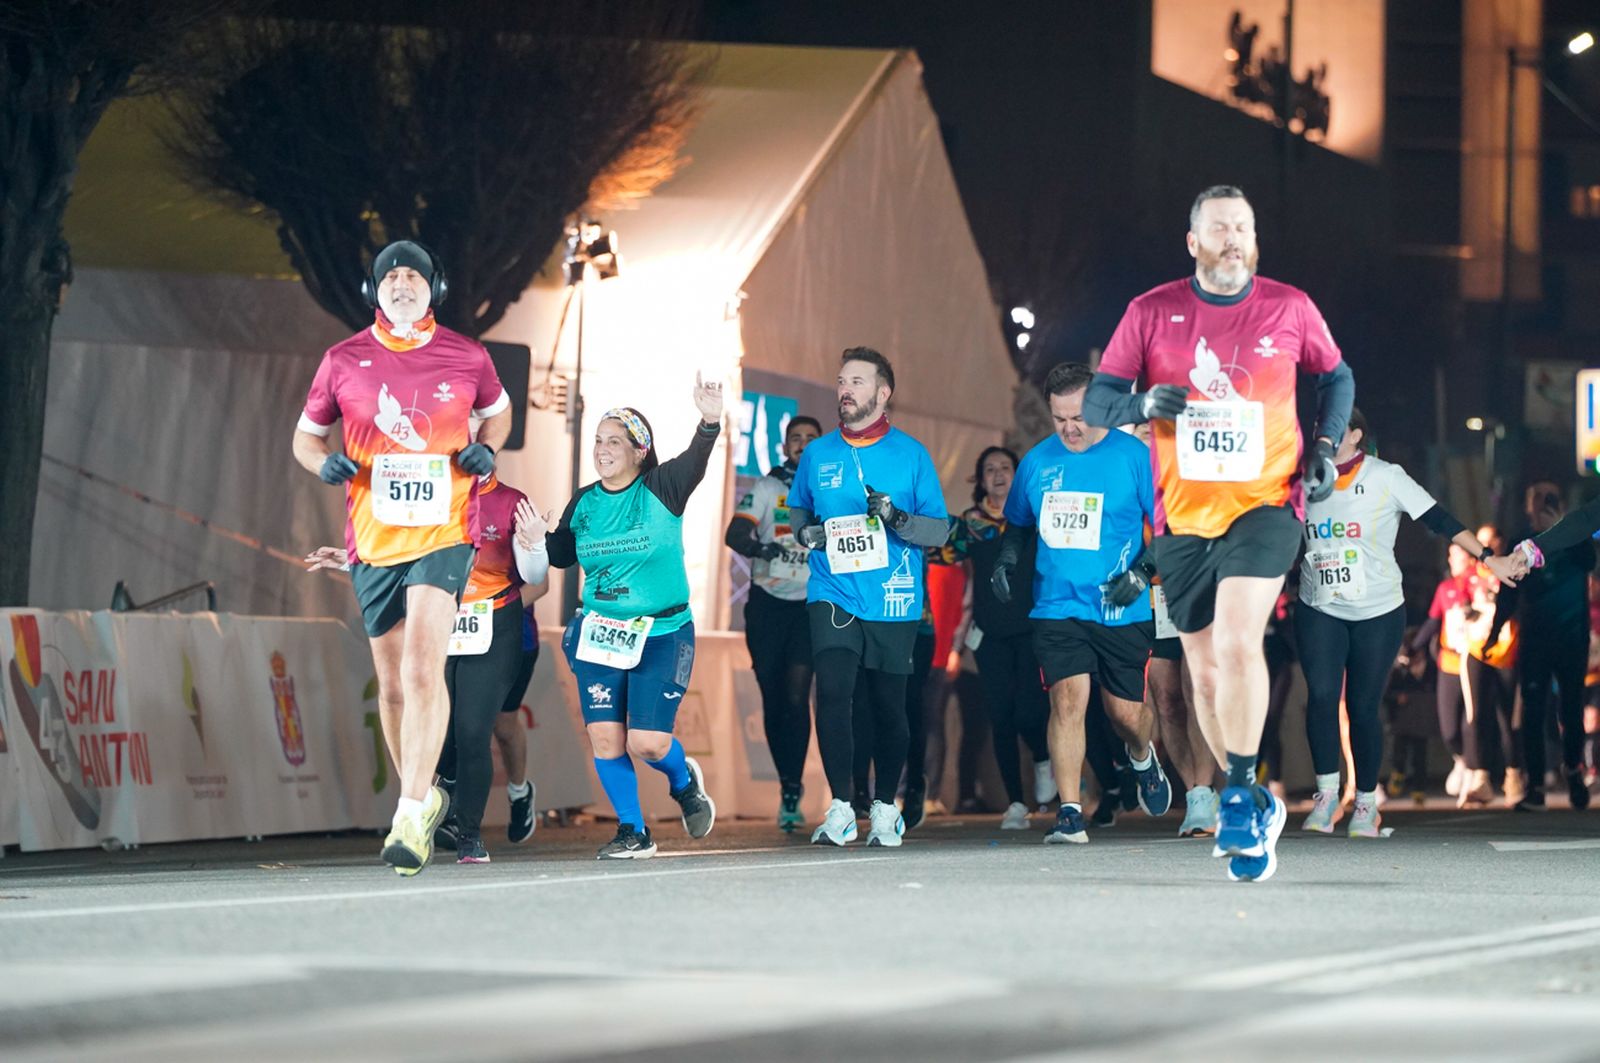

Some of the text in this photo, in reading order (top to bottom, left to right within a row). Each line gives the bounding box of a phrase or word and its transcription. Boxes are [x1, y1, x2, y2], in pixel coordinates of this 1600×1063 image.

[1207, 379, 1228, 399] 43
[391, 422, 410, 440] 43
[1194, 430, 1248, 453] 6452
[389, 480, 434, 501] 5179
[1052, 512, 1088, 529] 5729
[585, 540, 615, 550] CARRERA
[616, 535, 650, 546] POPULAR
[837, 534, 874, 554] 4651
[780, 550, 808, 564] 624
[588, 624, 638, 650] 13464
[63, 669, 117, 725] SAN
